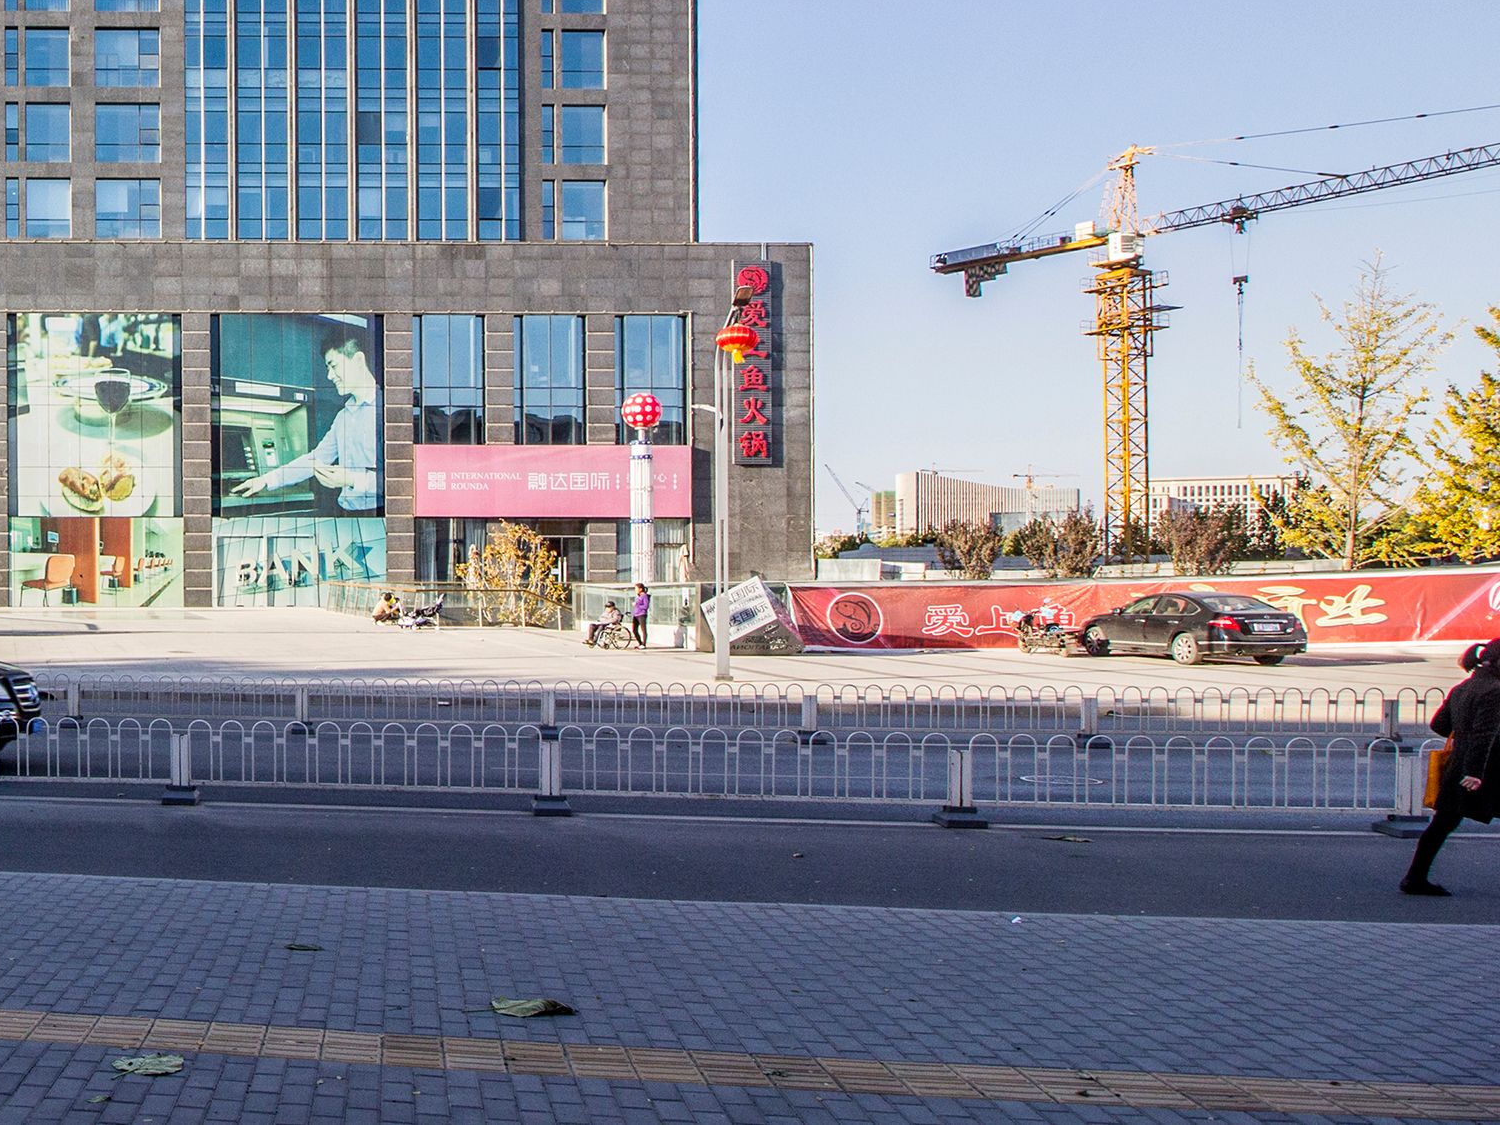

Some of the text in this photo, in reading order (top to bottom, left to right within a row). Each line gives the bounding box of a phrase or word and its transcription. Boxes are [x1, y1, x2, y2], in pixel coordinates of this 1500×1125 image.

[451, 472, 522, 481] INTERNATIONAL
[528, 472, 610, 491] 融达国际
[451, 482, 490, 491] ROUNDA
[236, 541, 363, 587] BANK
